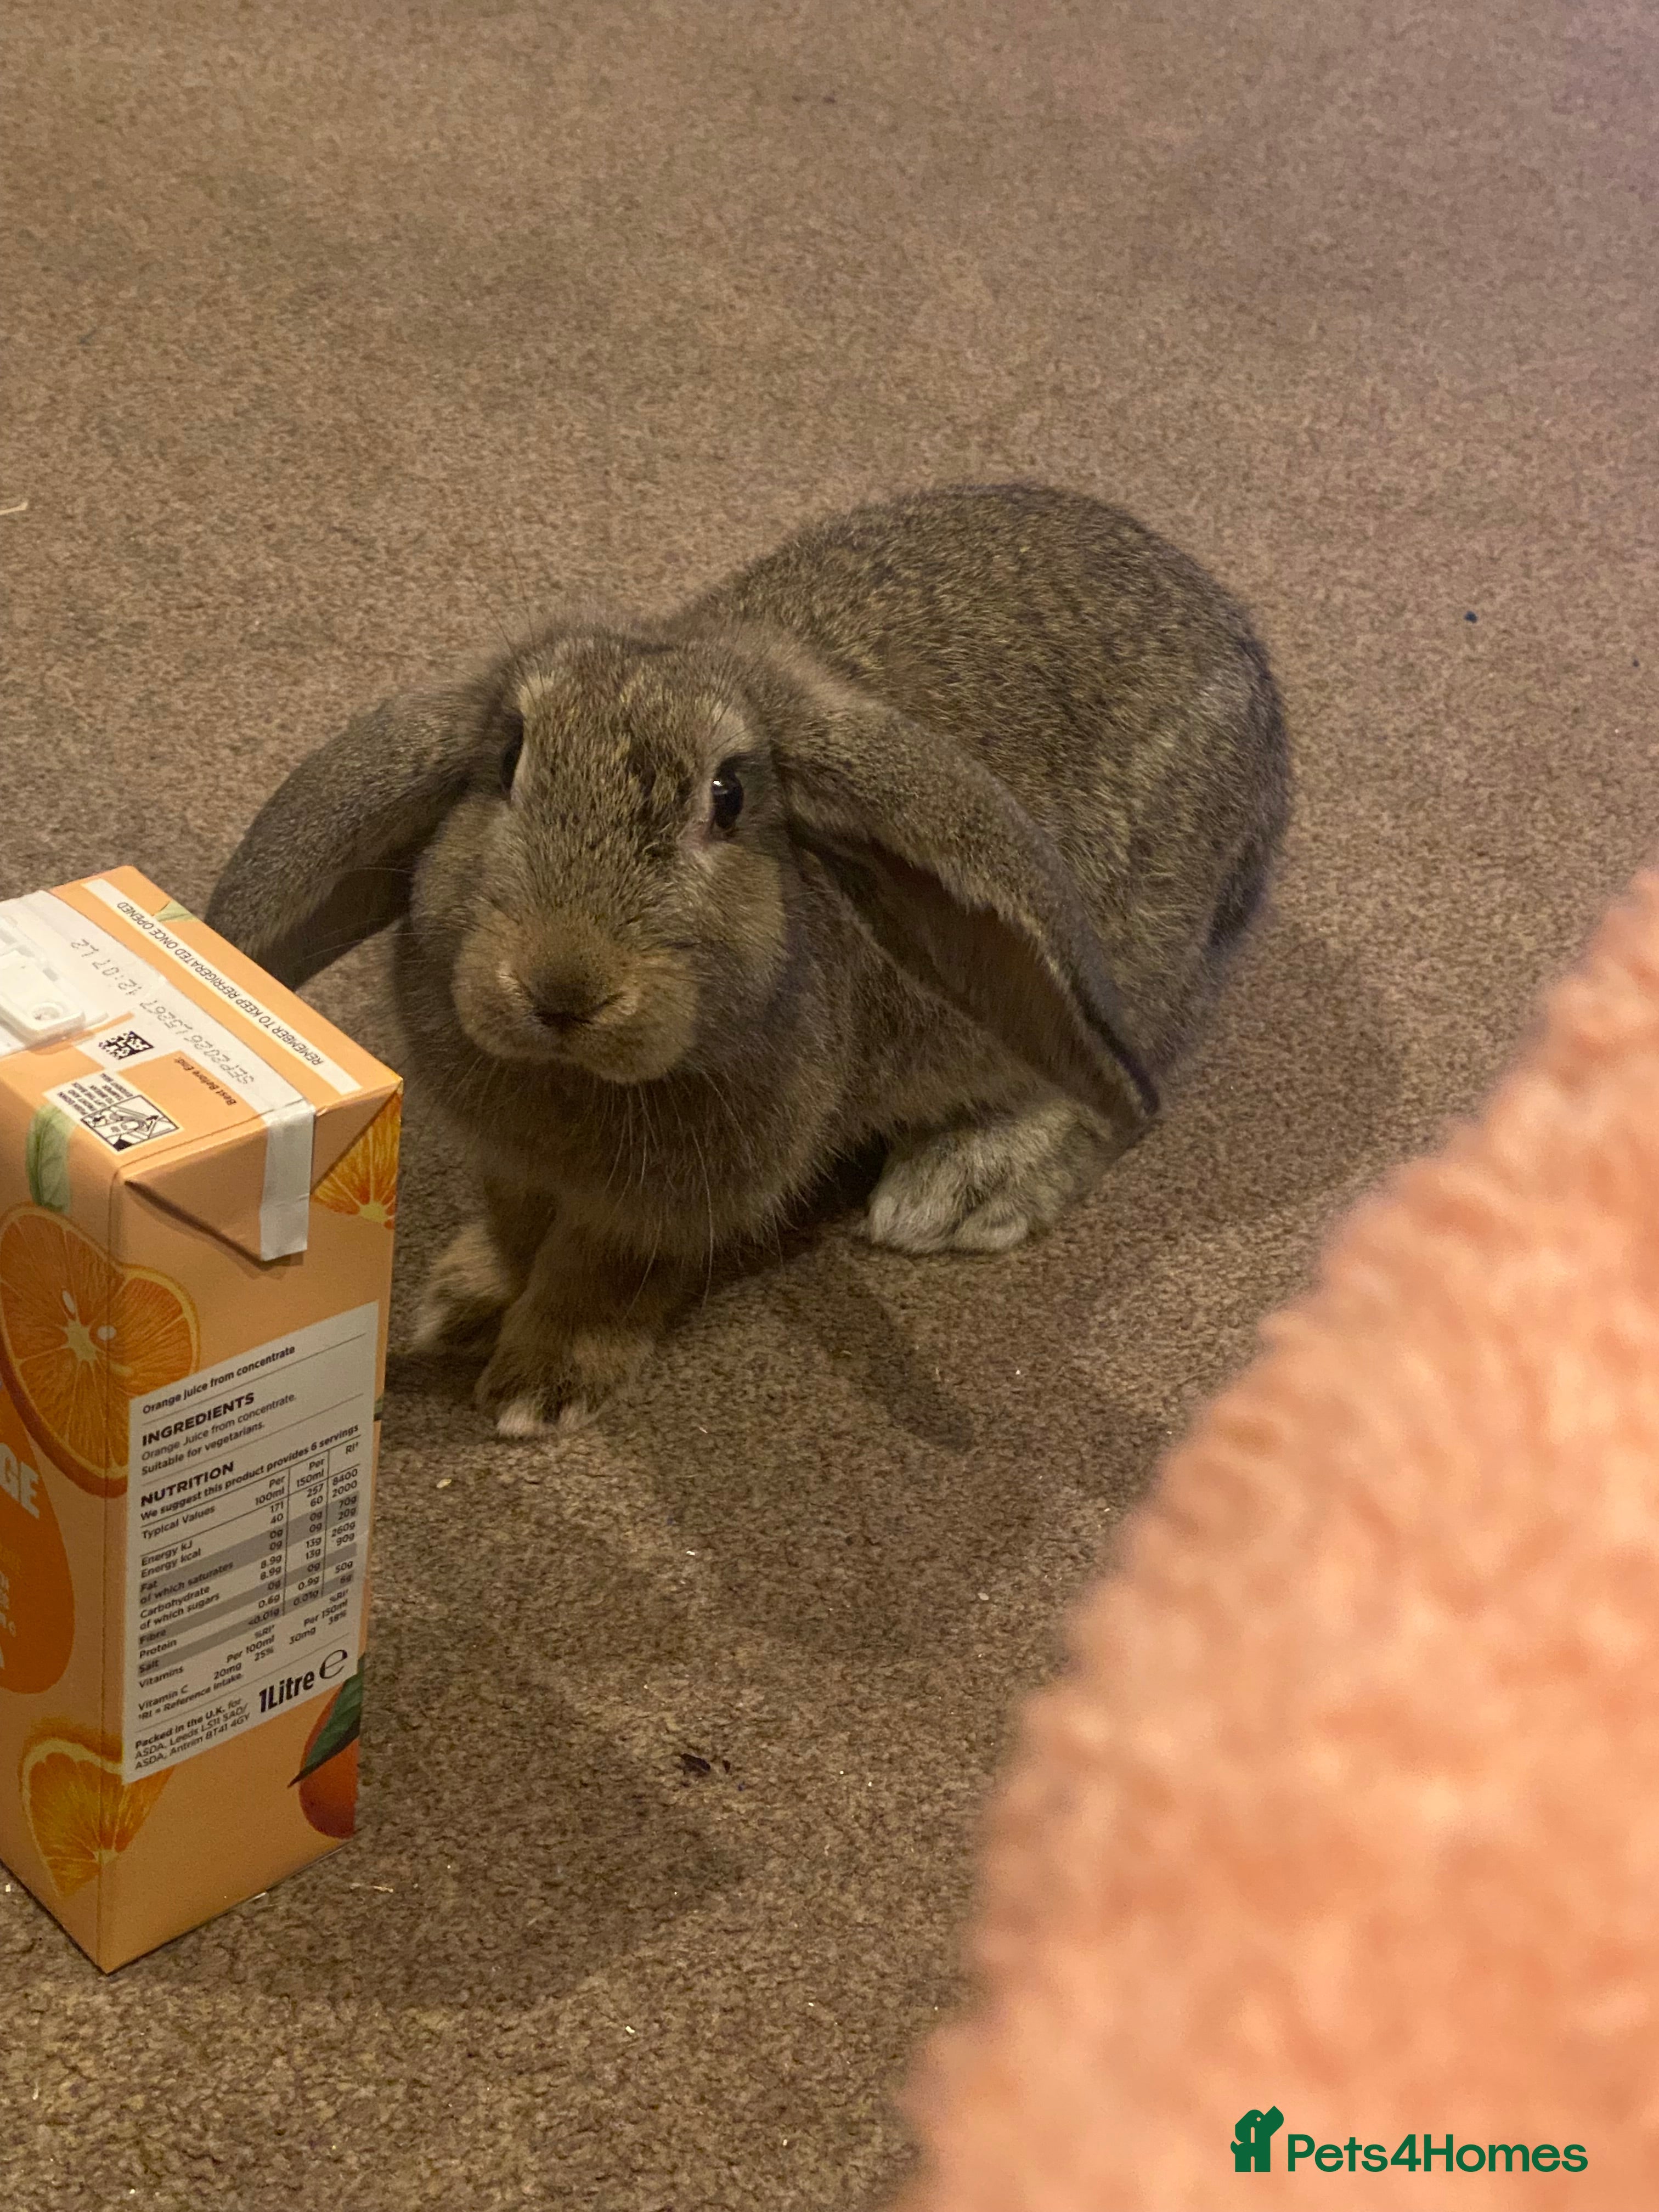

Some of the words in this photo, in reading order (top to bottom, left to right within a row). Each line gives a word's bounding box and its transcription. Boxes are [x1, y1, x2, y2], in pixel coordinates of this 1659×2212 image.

[117, 902, 154, 929] OPENED
[149, 929, 178, 949] ONCE
[174, 949, 239, 998] REFRIGERATED
[236, 998, 263, 1017] KEEP
[259, 1015, 275, 1028] TO
[184, 1035, 230, 1063] 2026
[272, 1026, 324, 1065] REMEMBER
[192, 1070, 219, 1090] Before
[215, 1090, 236, 1105] Best
[220, 1065, 254, 1084] SEP
[143, 1394, 182, 1414] Orange
[210, 1372, 234, 1387] from
[236, 1346, 295, 1376] concentrate
[142, 1441, 180, 1460] Orange
[211, 1419, 235, 1434] from
[238, 1394, 296, 1423] concentrate.
[143, 1392, 255, 1447] INGREDIENTS
[140, 1509, 157, 1521] We
[160, 1491, 202, 1514] suggest
[204, 1483, 223, 1497] this
[225, 1465, 264, 1489] product
[267, 1447, 309, 1472] provides
[311, 1442, 317, 1451] 6
[319, 1425, 358, 1448] servings
[142, 1453, 184, 1476] Suitable
[187, 1447, 202, 1458] for
[205, 1421, 265, 1451] vegetarians.
[140, 1460, 234, 1508] NUTRITION
[142, 1519, 179, 1539] Typical
[183, 1505, 215, 1523] Values
[269, 1476, 285, 1489] Per
[309, 1458, 325, 1471] Per
[255, 1486, 285, 1505] 100ml
[297, 1468, 324, 1487] 150ml
[141, 1559, 178, 1578] Energy
[180, 1548, 201, 1563] kcal
[270, 1513, 284, 1524] 40
[311, 1495, 323, 1507] 60
[332, 1480, 357, 1498] 2000
[142, 1547, 178, 1566] Energy
[181, 1539, 193, 1551] kJ
[271, 1501, 284, 1513] 171
[307, 1483, 324, 1498] 257
[332, 1468, 358, 1486] 8400
[140, 1580, 157, 1592] Fat
[270, 1530, 283, 1539] 0g
[309, 1511, 323, 1522] 0g
[339, 1496, 357, 1509] 70g
[140, 1594, 151, 1605] of
[154, 1582, 185, 1599] which
[188, 1562, 234, 1586] saturates
[269, 1541, 283, 1551] 0g
[309, 1522, 323, 1533] 0g
[338, 1508, 357, 1521] 20g
[139, 1619, 150, 1630] of
[154, 1608, 184, 1626] which
[187, 1593, 219, 1612] sugars
[260, 1566, 281, 1581] 8.9g
[306, 1549, 321, 1560] 13g
[336, 1533, 355, 1547] 90g
[140, 1586, 210, 1618] Carbohydrate
[306, 1537, 321, 1549] 13g
[331, 1521, 356, 1537] 260g
[139, 1629, 166, 1645] Fibre
[268, 1580, 281, 1590] 0g
[307, 1562, 320, 1572] 0g
[139, 1639, 177, 1659] Protein
[258, 1594, 280, 1609] 0.6g
[298, 1576, 320, 1590] 0.9g
[335, 1561, 353, 1574] 50g
[227, 1651, 242, 1664] Per
[246, 1634, 274, 1654] 100ml
[304, 1615, 319, 1627] Per
[322, 1599, 348, 1619] 150ml
[138, 1690, 178, 1711] Vitamin
[180, 1684, 189, 1694] C
[213, 1662, 242, 1680] 20mg
[255, 1647, 274, 1661] 25%
[289, 1627, 316, 1645] 30mg
[139, 1660, 159, 1673] Salt
[139, 1666, 184, 1689] Vitamins
[164, 1686, 211, 1711] Reference
[135, 1728, 173, 1749] Packed
[176, 1724, 184, 1733] in
[187, 1716, 203, 1728] the
[206, 1706, 225, 1720] U.K.
[228, 1699, 242, 1709] for
[170, 1736, 203, 1756] Antrim
[206, 1724, 228, 1740] BT41
[230, 1712, 250, 1728] 4GY
[170, 1728, 198, 1746] Leeds
